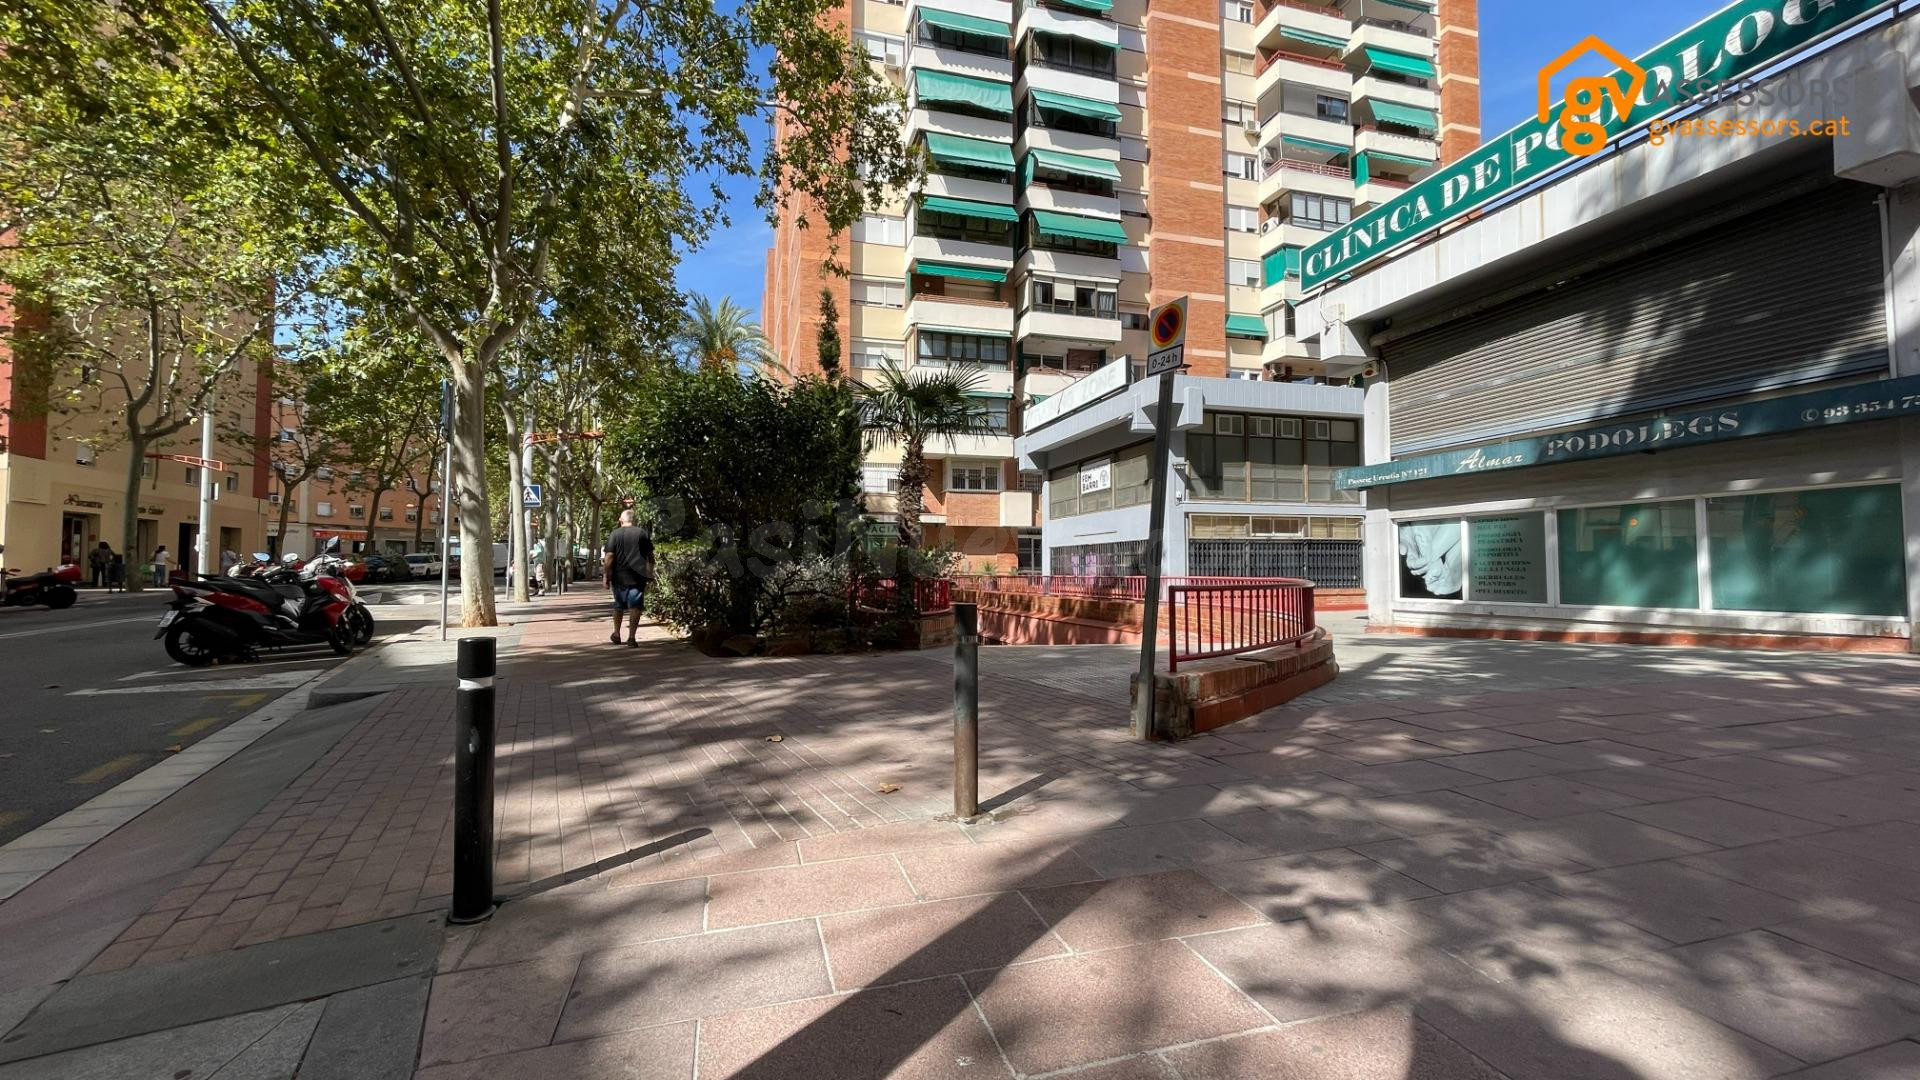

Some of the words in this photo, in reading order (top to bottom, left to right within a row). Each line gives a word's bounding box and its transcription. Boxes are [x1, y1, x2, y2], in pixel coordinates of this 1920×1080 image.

[1306, 194, 1433, 277] CLÍNICA
[1440, 152, 1501, 211] DE
[1823, 405, 1850, 418] 93
[1547, 411, 1740, 456] PODOLEGS
[1456, 448, 1525, 473] Almar
